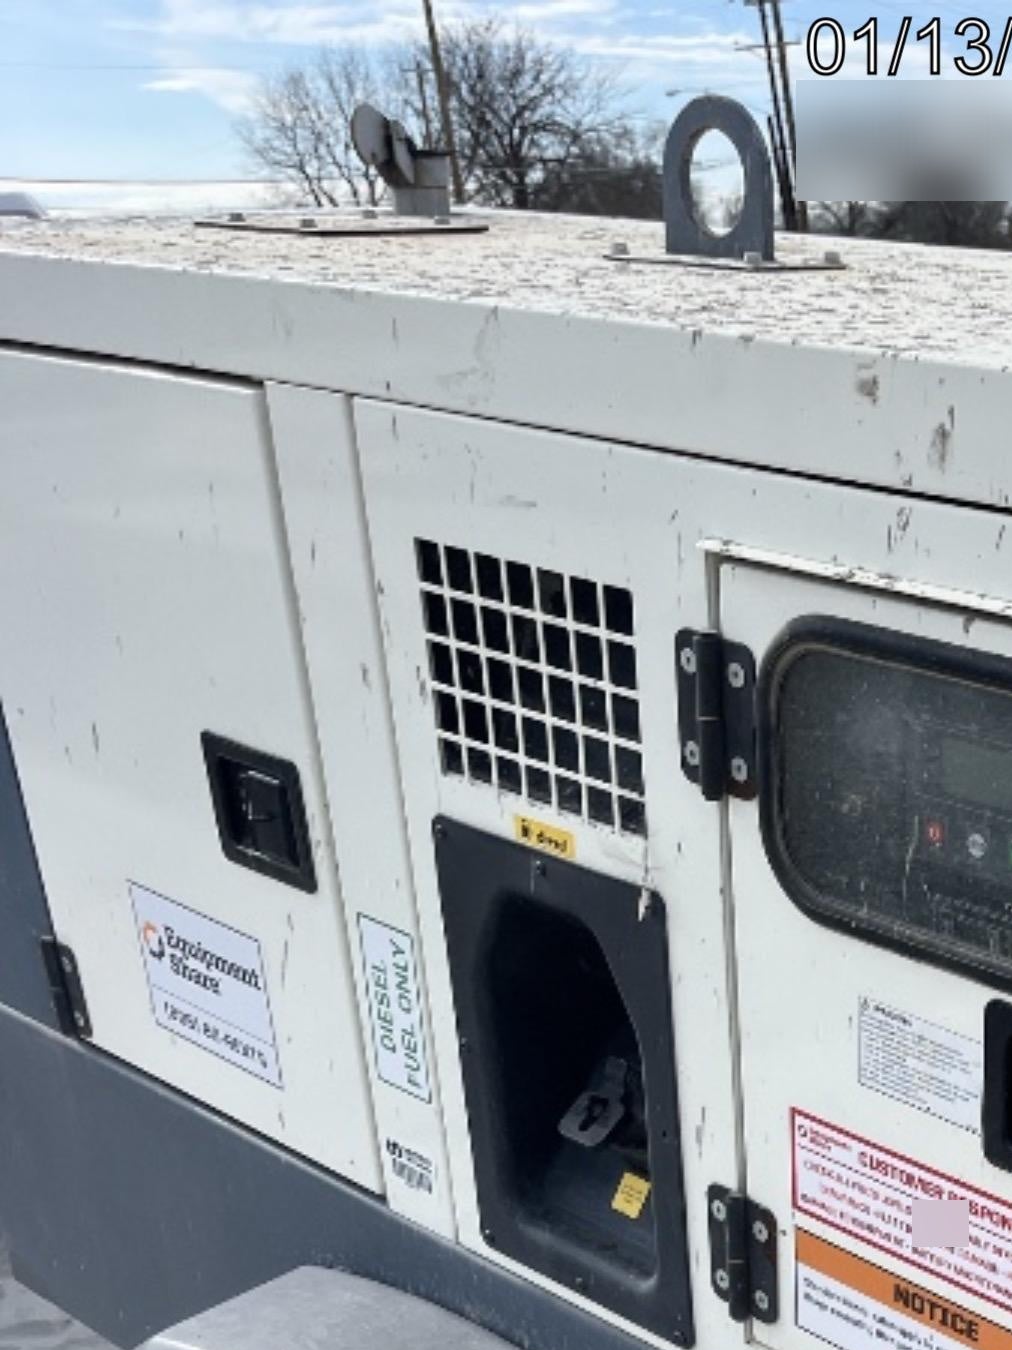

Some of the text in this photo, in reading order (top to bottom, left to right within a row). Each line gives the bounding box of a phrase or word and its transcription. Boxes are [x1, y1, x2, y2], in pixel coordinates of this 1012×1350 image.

[371, 960, 397, 1054] DIESEL
[389, 938, 422, 1089] FUEL ONLY
[858, 1151, 944, 1202] CUSTOMER
[894, 1283, 978, 1342] NOTICE
